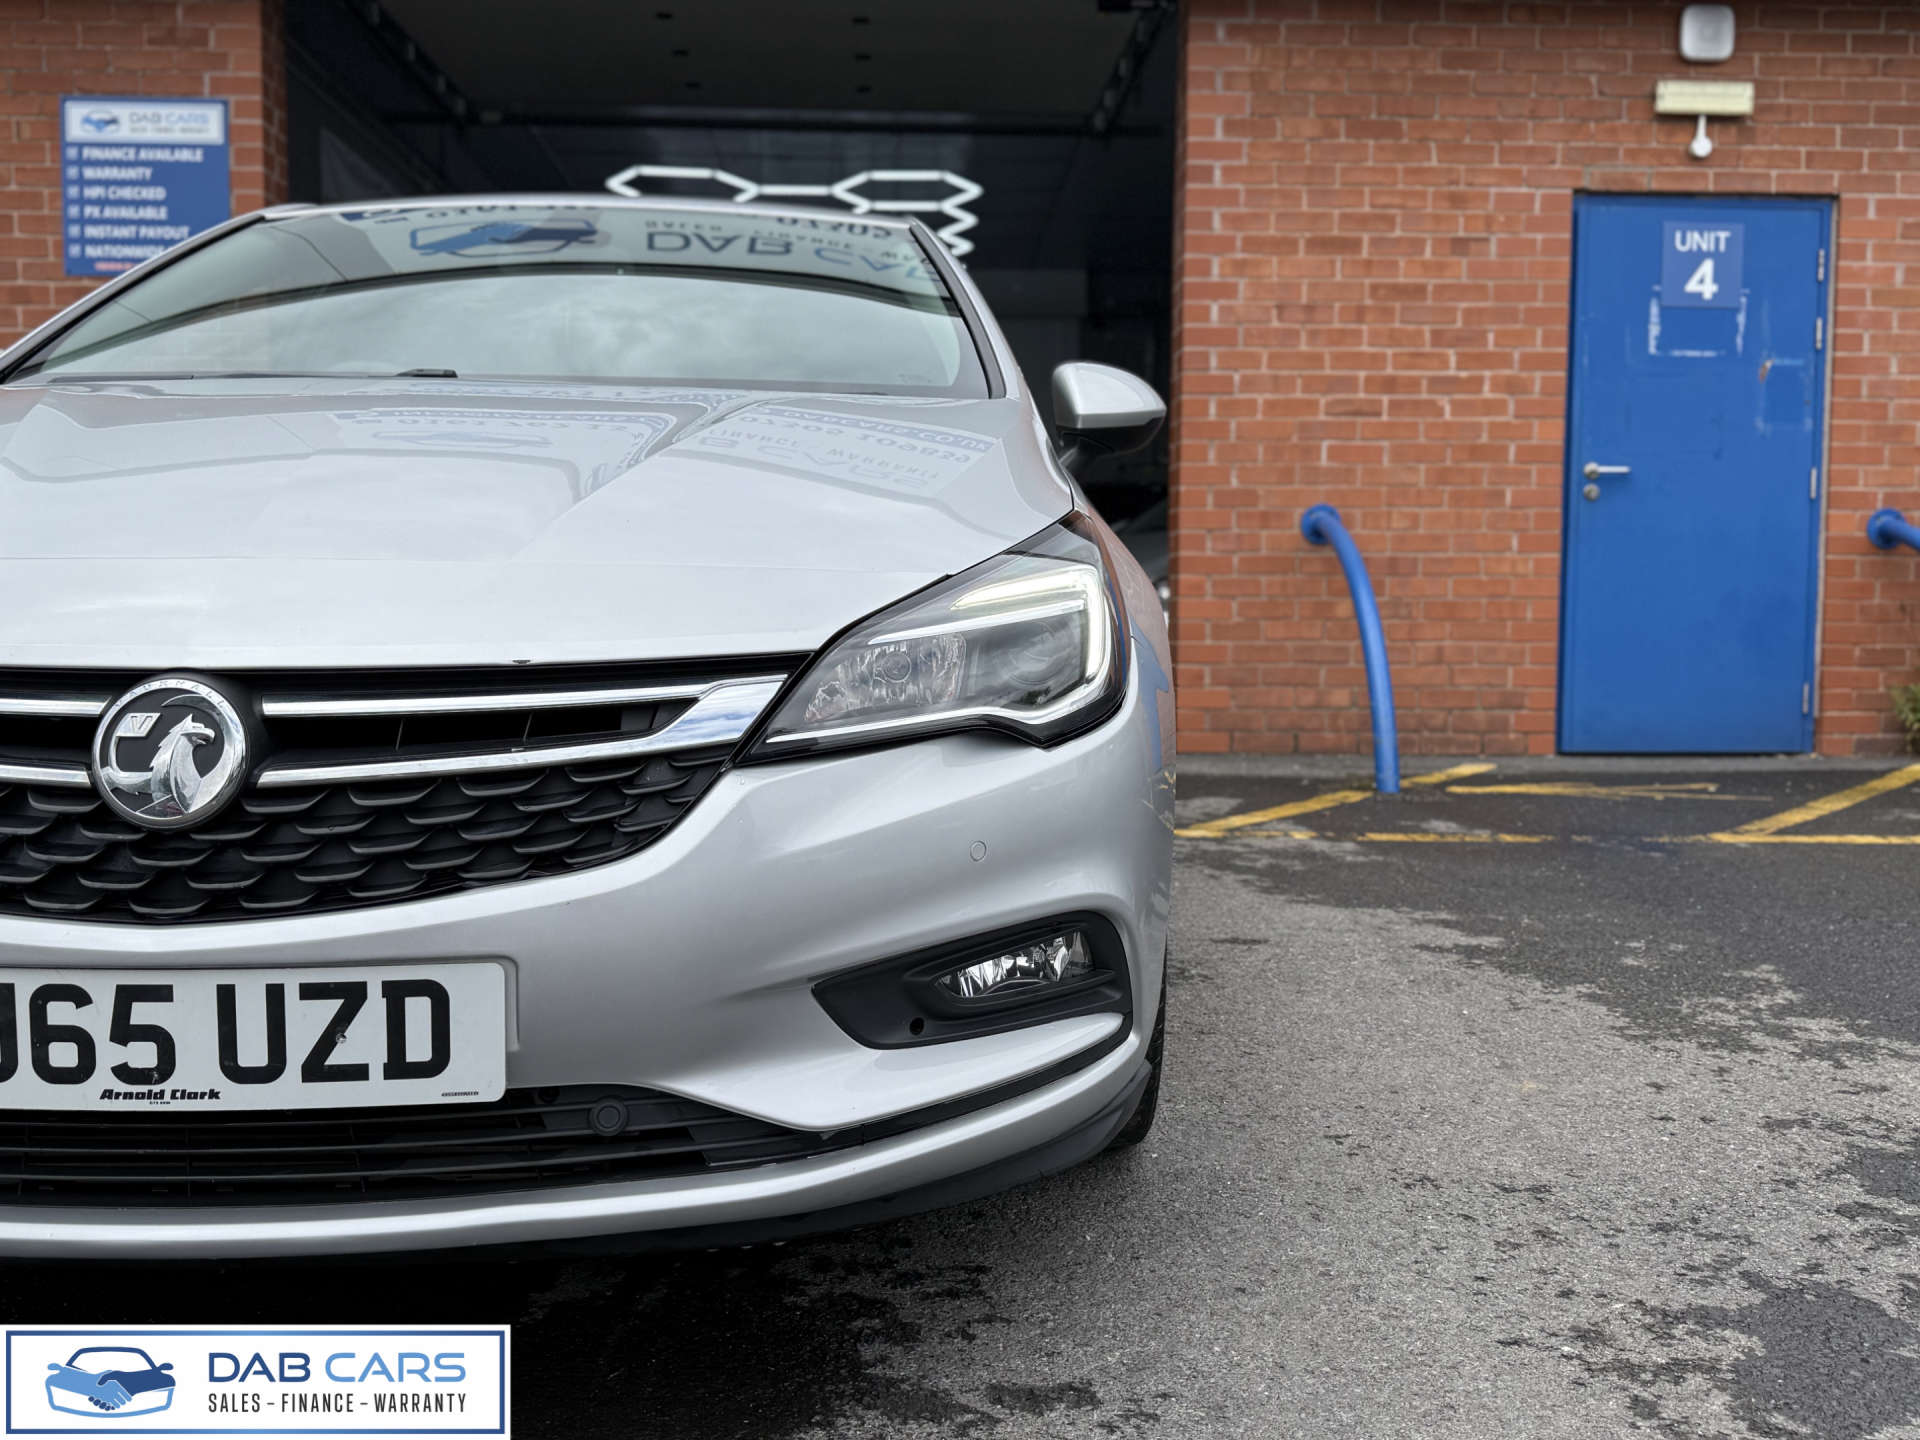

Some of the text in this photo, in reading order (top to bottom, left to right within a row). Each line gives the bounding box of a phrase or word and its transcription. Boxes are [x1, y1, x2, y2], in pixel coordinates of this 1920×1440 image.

[82, 146, 204, 162] FINANCE AVAILABLE
[82, 166, 153, 180] WARRANTY
[107, 186, 167, 200] CHECKED
[103, 206, 168, 220] AVAILABLE
[84, 225, 190, 240] INSTANT PAYOUT
[1674, 229, 1731, 252] UNIT
[1683, 257, 1719, 300] 4
[216, 979, 451, 1085] UZD
[99, 1088, 221, 1101] Arnold Clark
